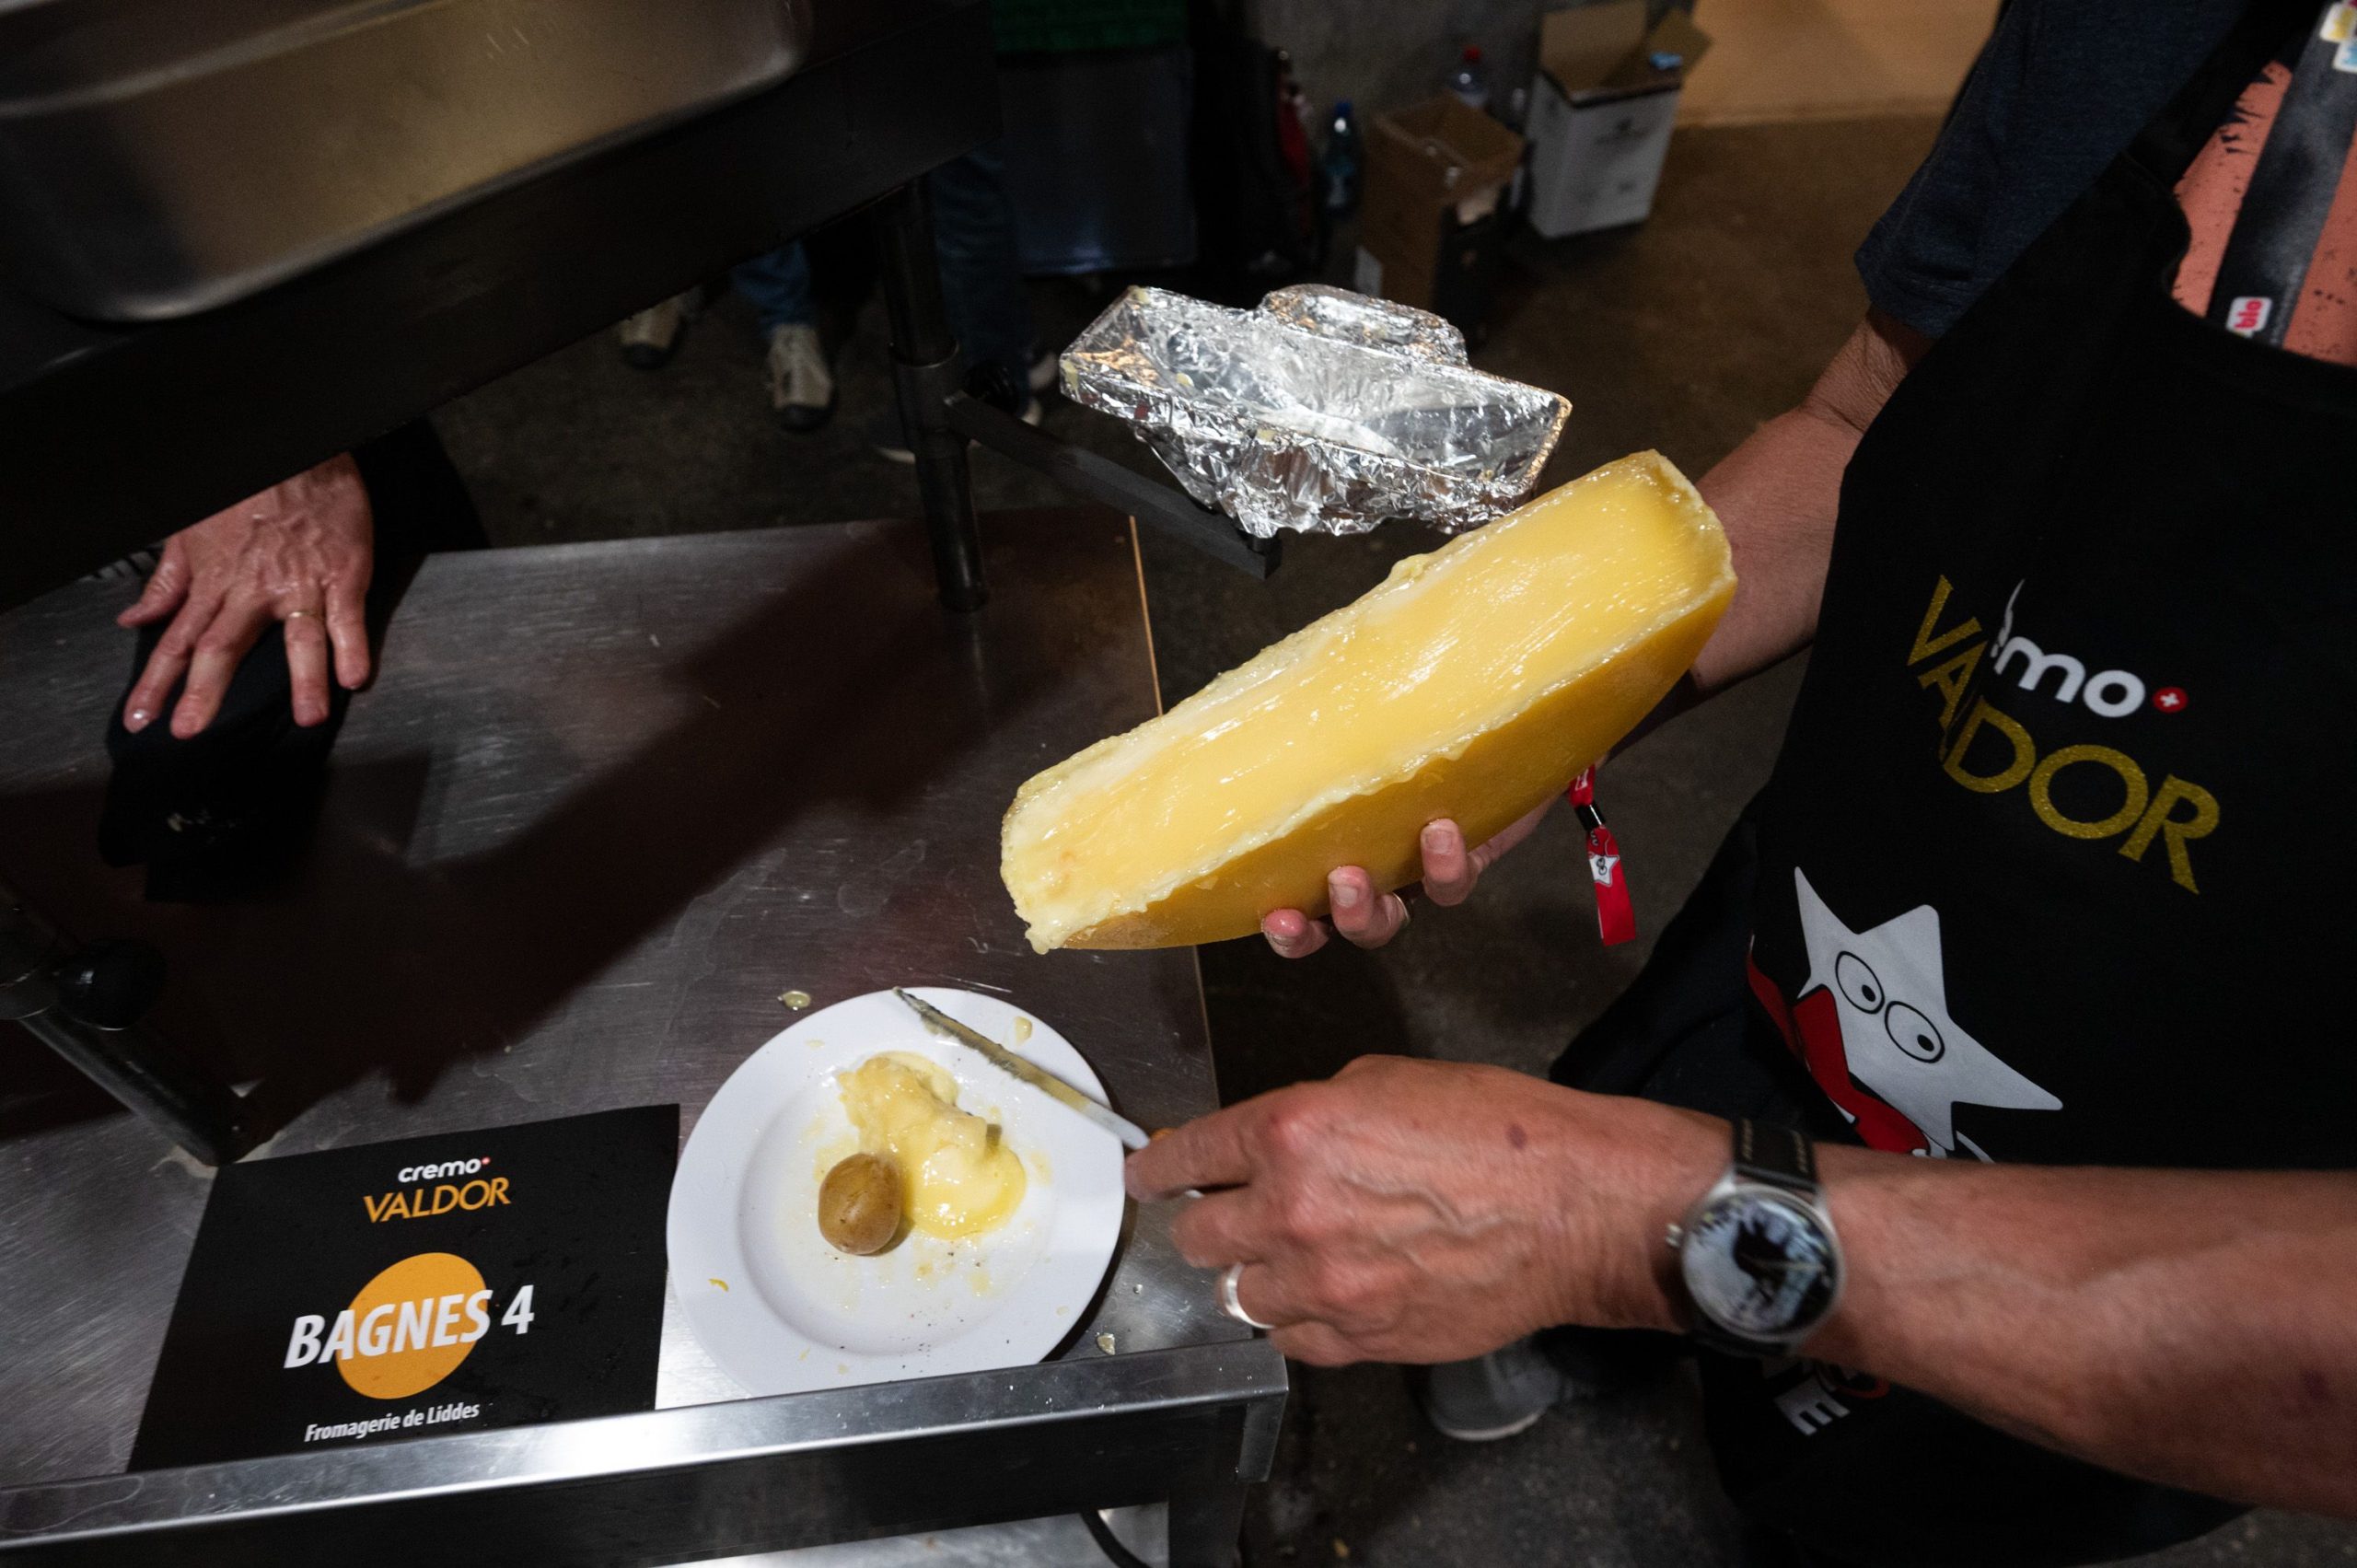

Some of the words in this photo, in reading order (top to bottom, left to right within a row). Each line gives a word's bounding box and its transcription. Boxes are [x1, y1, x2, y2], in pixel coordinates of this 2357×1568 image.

[398, 1158, 481, 1183] cremo
[363, 1177, 512, 1224] VALDOR
[284, 1289, 493, 1369] BAGNES
[502, 1284, 534, 1335] 4
[304, 1412, 401, 1443] Fromagerie
[402, 1409, 424, 1428] de
[426, 1401, 480, 1425] Liddes
